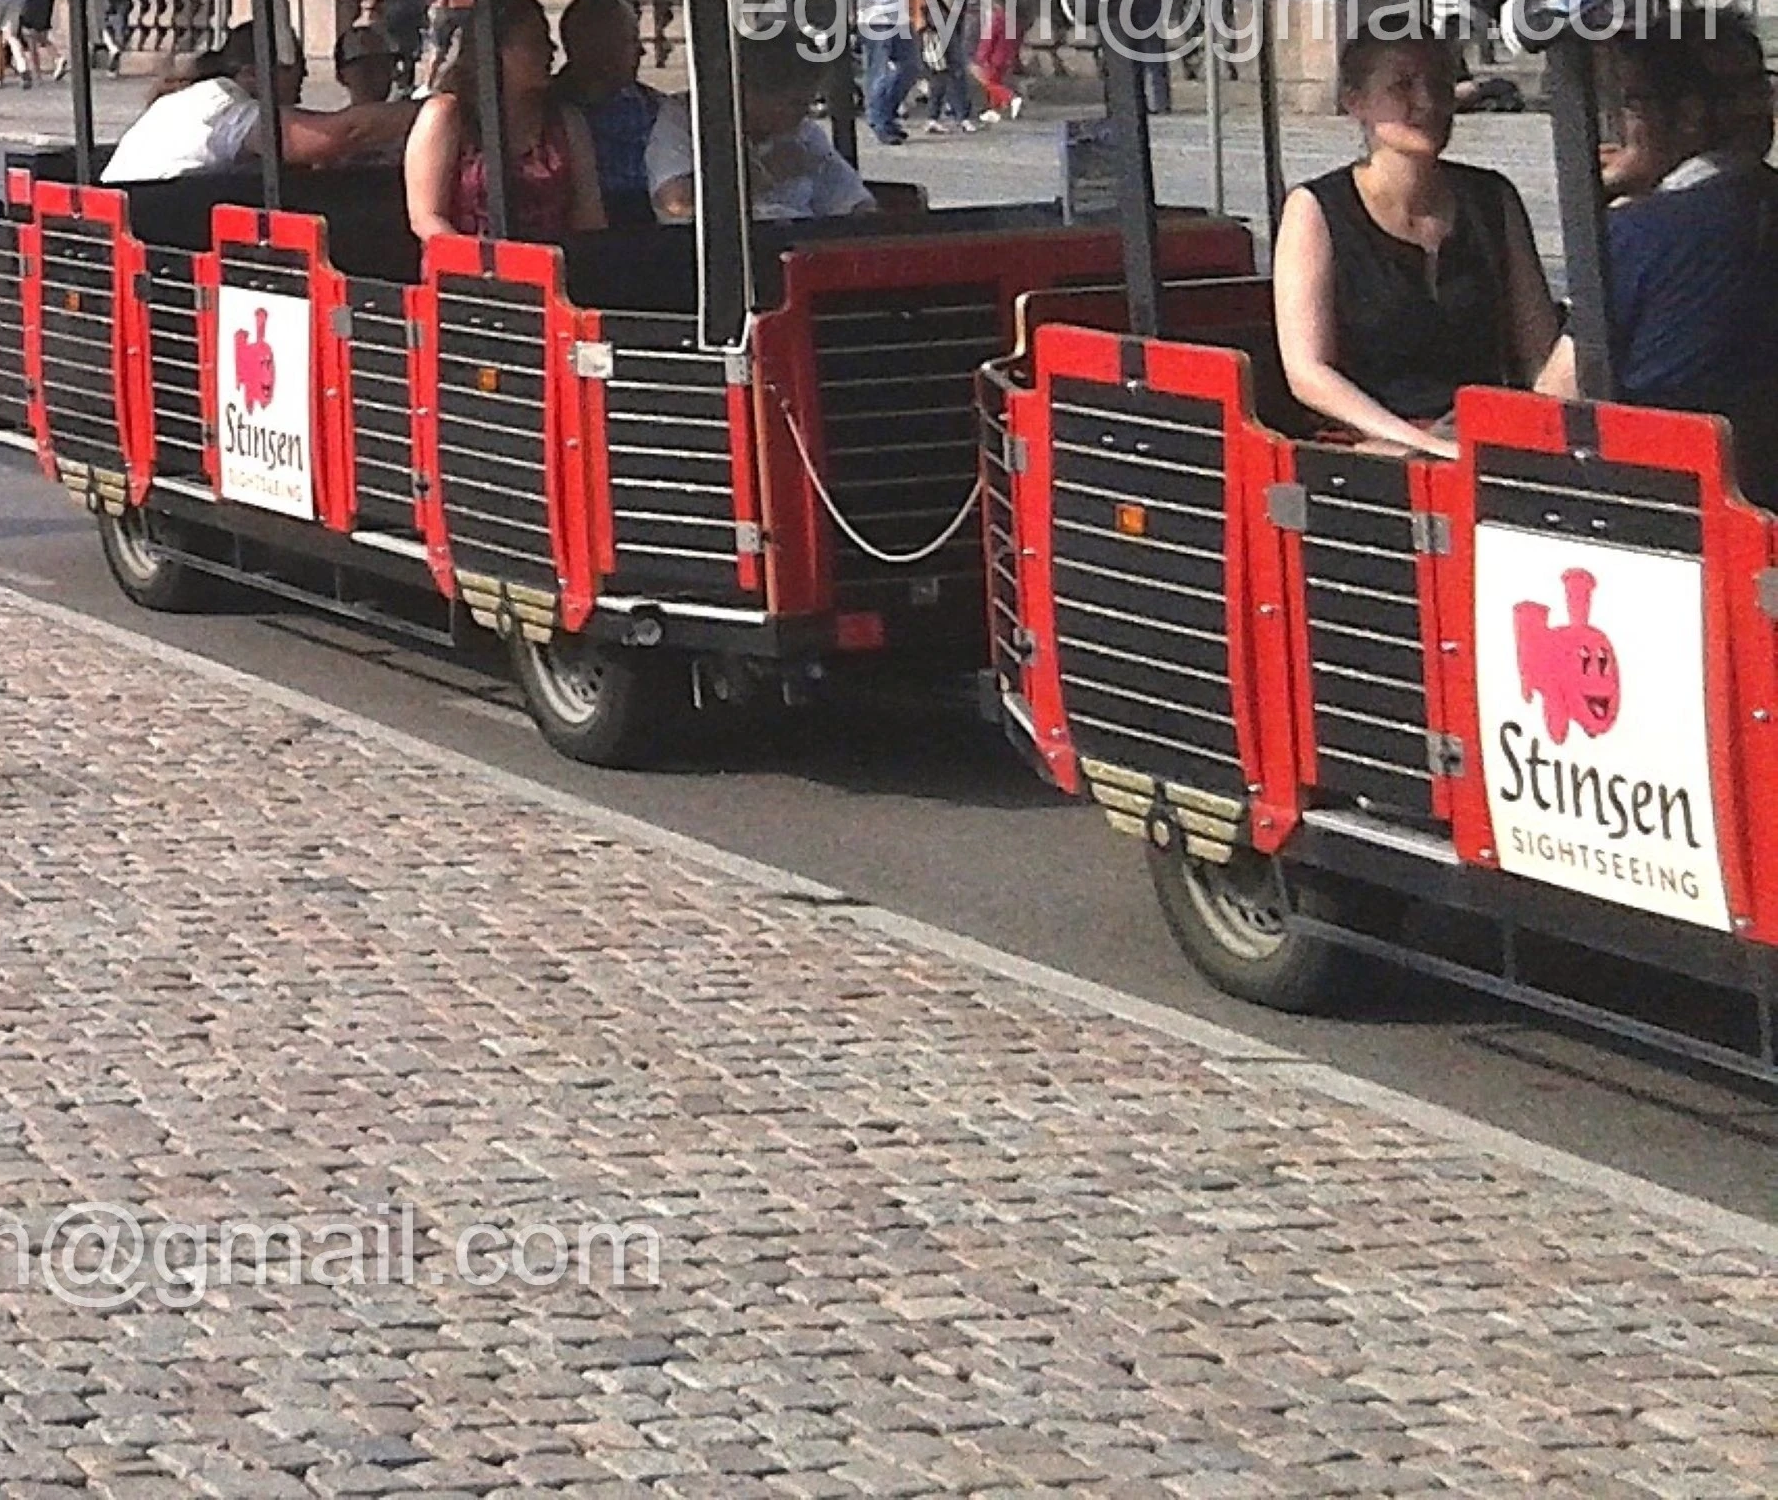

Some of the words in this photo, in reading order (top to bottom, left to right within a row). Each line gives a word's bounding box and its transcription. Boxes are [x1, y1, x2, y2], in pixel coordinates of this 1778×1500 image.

[225, 403, 303, 471] Stinsen
[1499, 721, 1702, 848] Stinsen
[1511, 826, 1700, 900] SIGHTSEEING
